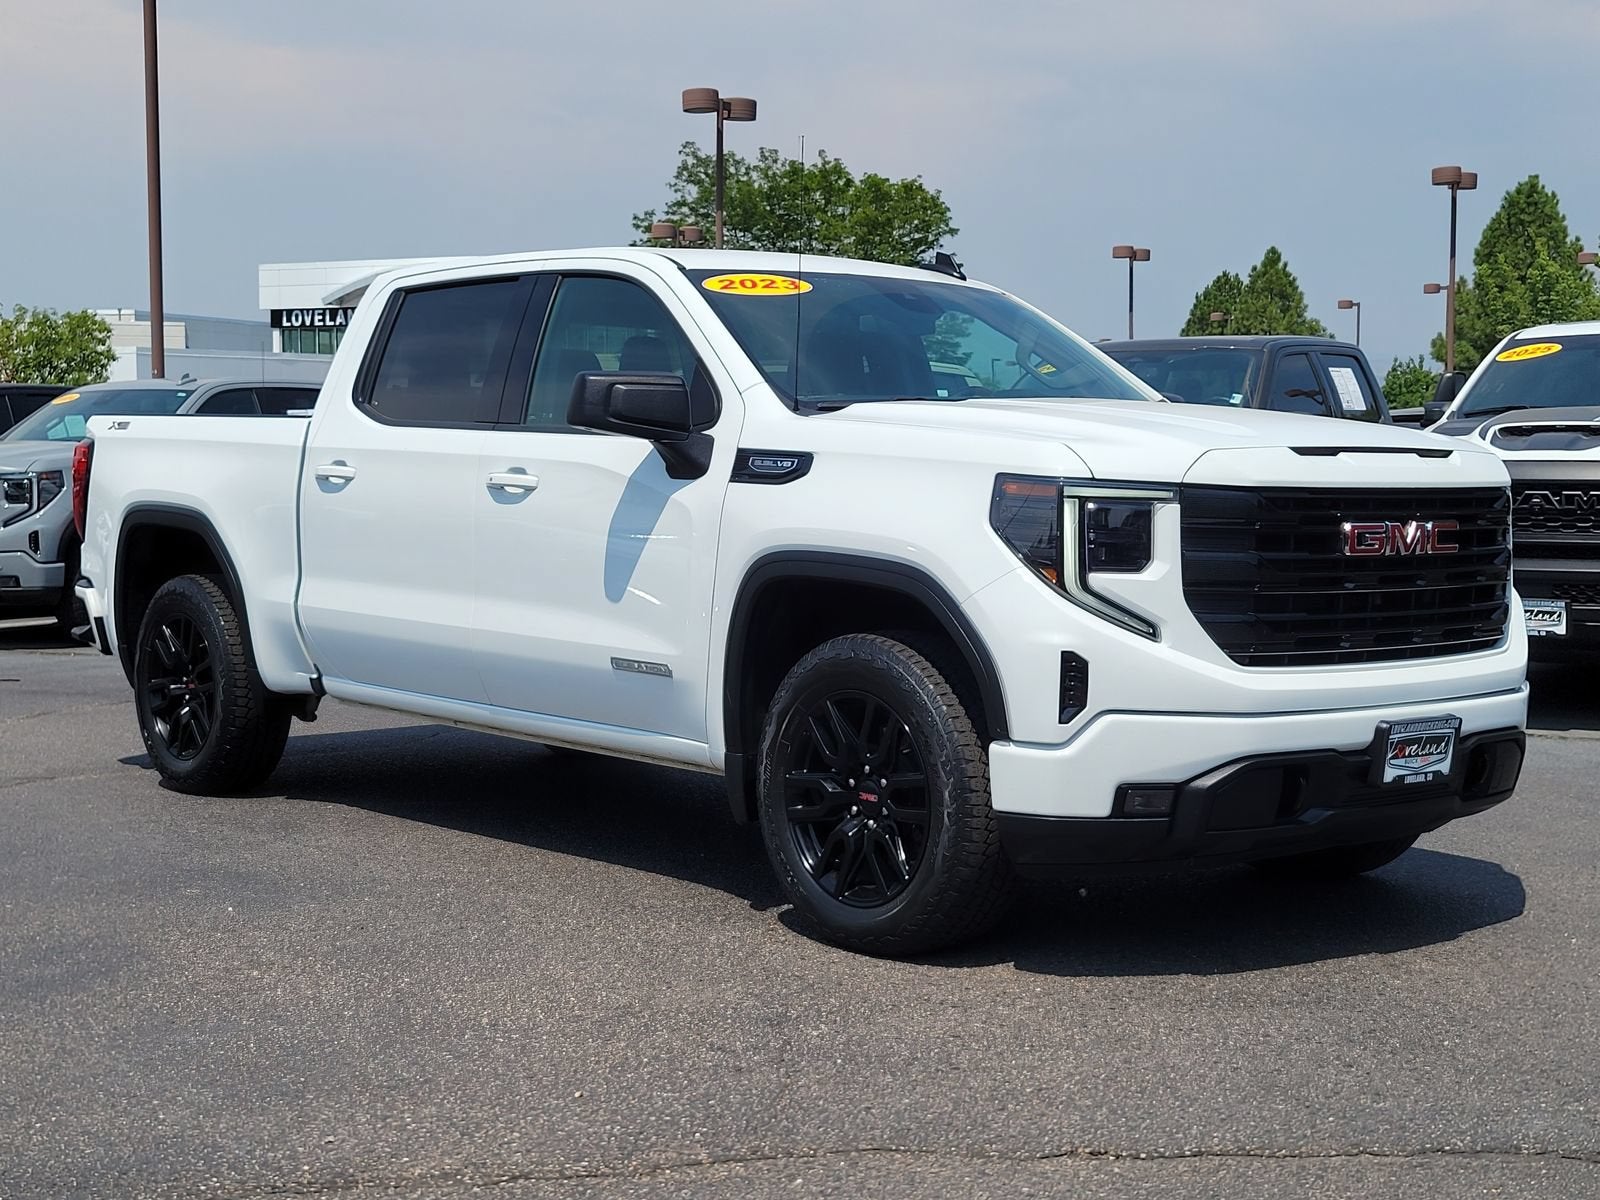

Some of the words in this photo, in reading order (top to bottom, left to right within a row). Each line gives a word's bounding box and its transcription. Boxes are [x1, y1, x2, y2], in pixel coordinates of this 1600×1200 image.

[718, 278, 800, 291] 2023
[1502, 345, 1556, 359] 2025
[1513, 490, 1600, 510] AM
[1340, 519, 1460, 556] GMC
[1524, 608, 1561, 622] eland
